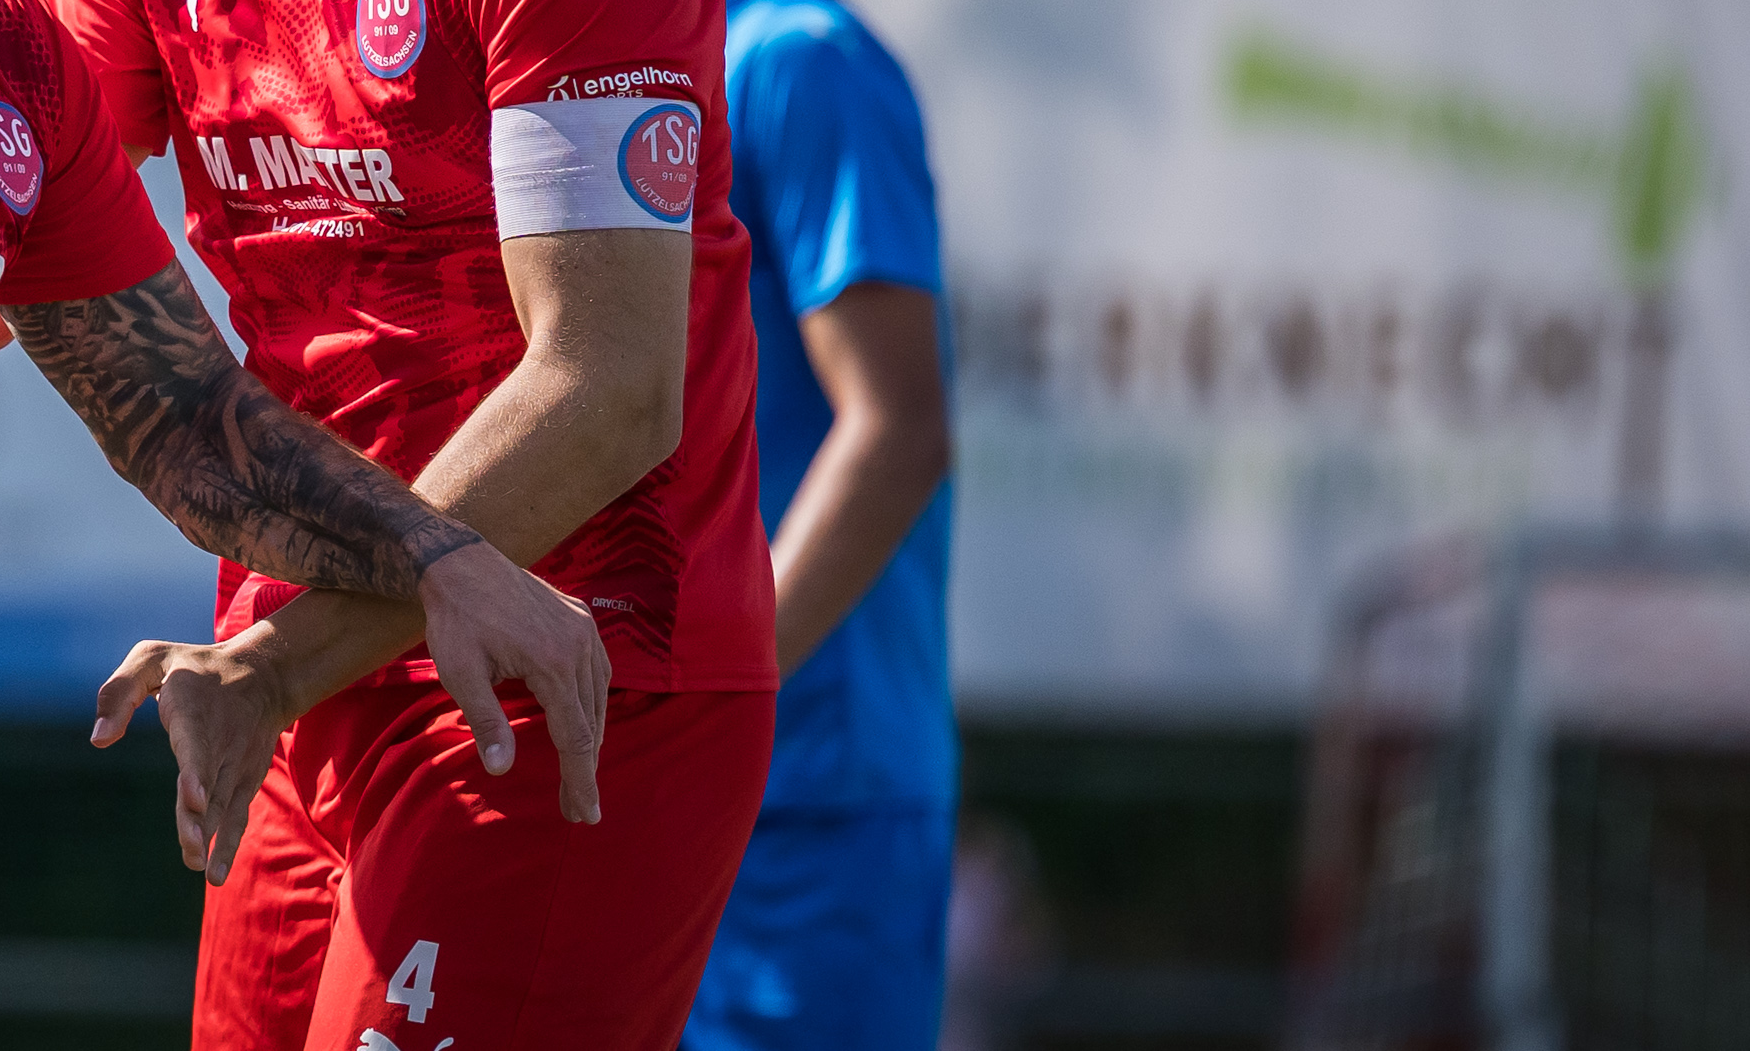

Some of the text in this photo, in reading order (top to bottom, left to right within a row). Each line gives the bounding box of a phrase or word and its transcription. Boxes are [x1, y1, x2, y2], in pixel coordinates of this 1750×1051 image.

[584, 67, 693, 95] engelhorn
[642, 115, 697, 166] TSG
[197, 136, 248, 191] M.
[283, 195, 330, 210] Sanitär
[592, 597, 635, 613] DRYCELL
[385, 939, 439, 1024] 4
